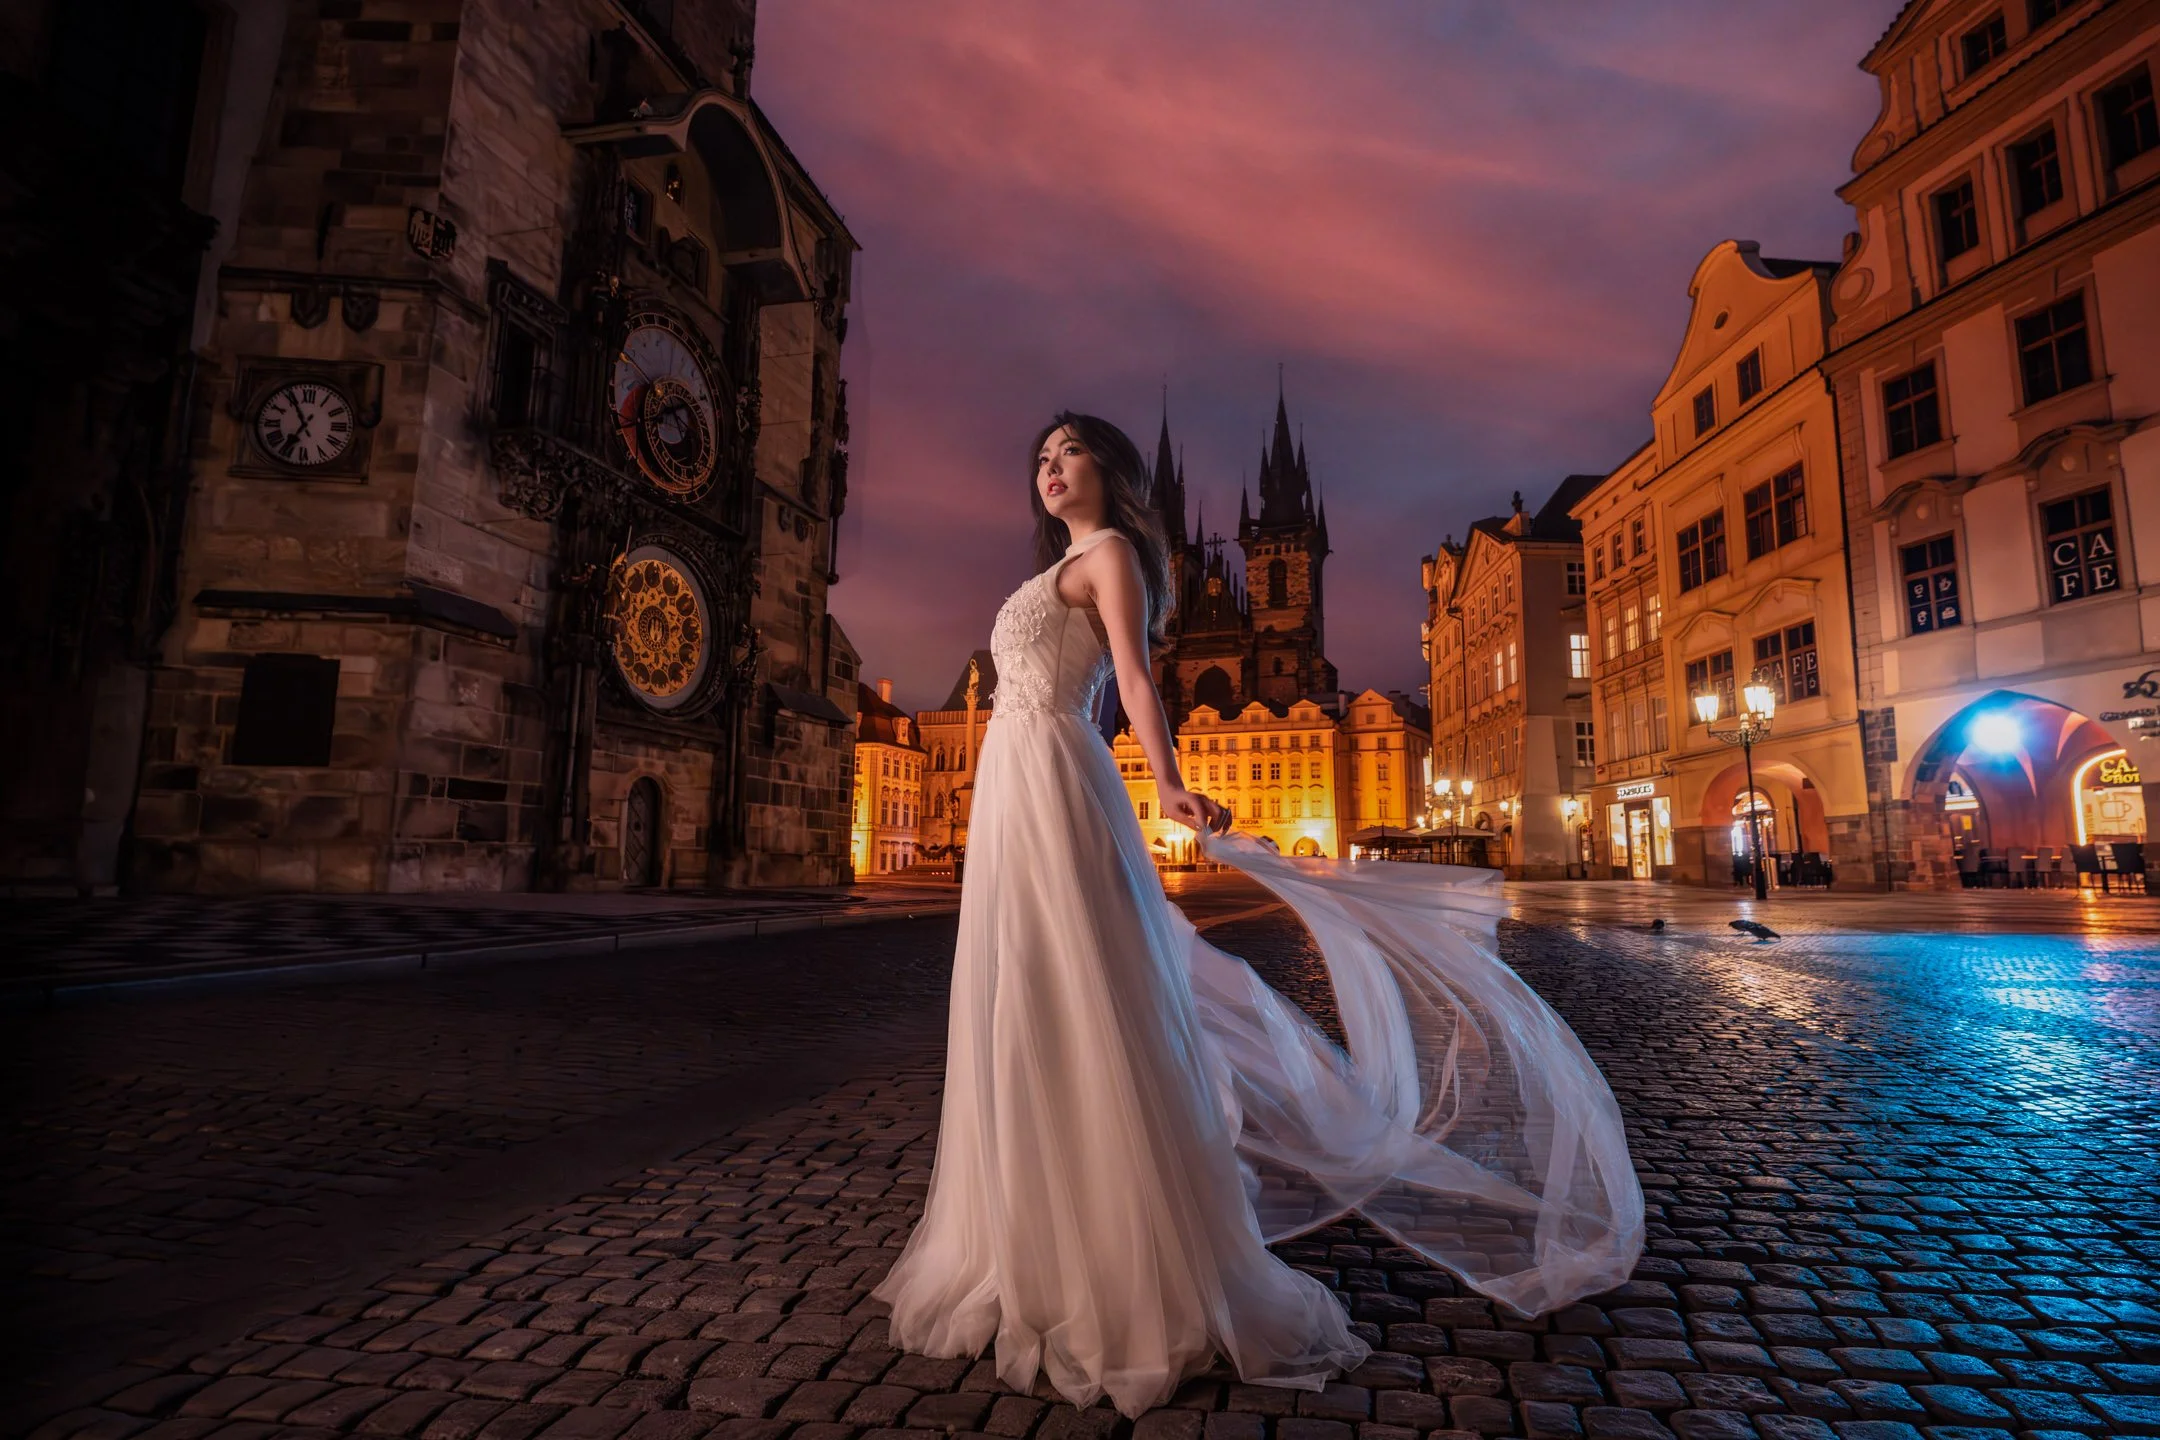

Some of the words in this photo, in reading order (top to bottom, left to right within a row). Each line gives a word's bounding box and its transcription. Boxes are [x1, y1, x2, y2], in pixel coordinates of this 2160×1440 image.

[302, 389, 316, 403] XII
[320, 393, 331, 407] I
[272, 405, 286, 414] X
[328, 407, 344, 417] II
[264, 419, 280, 427] IX
[331, 422, 347, 431] III
[299, 448, 308, 460] VI
[317, 445, 330, 460] V
[2053, 533, 2115, 566] CA
[2058, 564, 2118, 598] FE
[1758, 651, 1817, 683] CAFE
